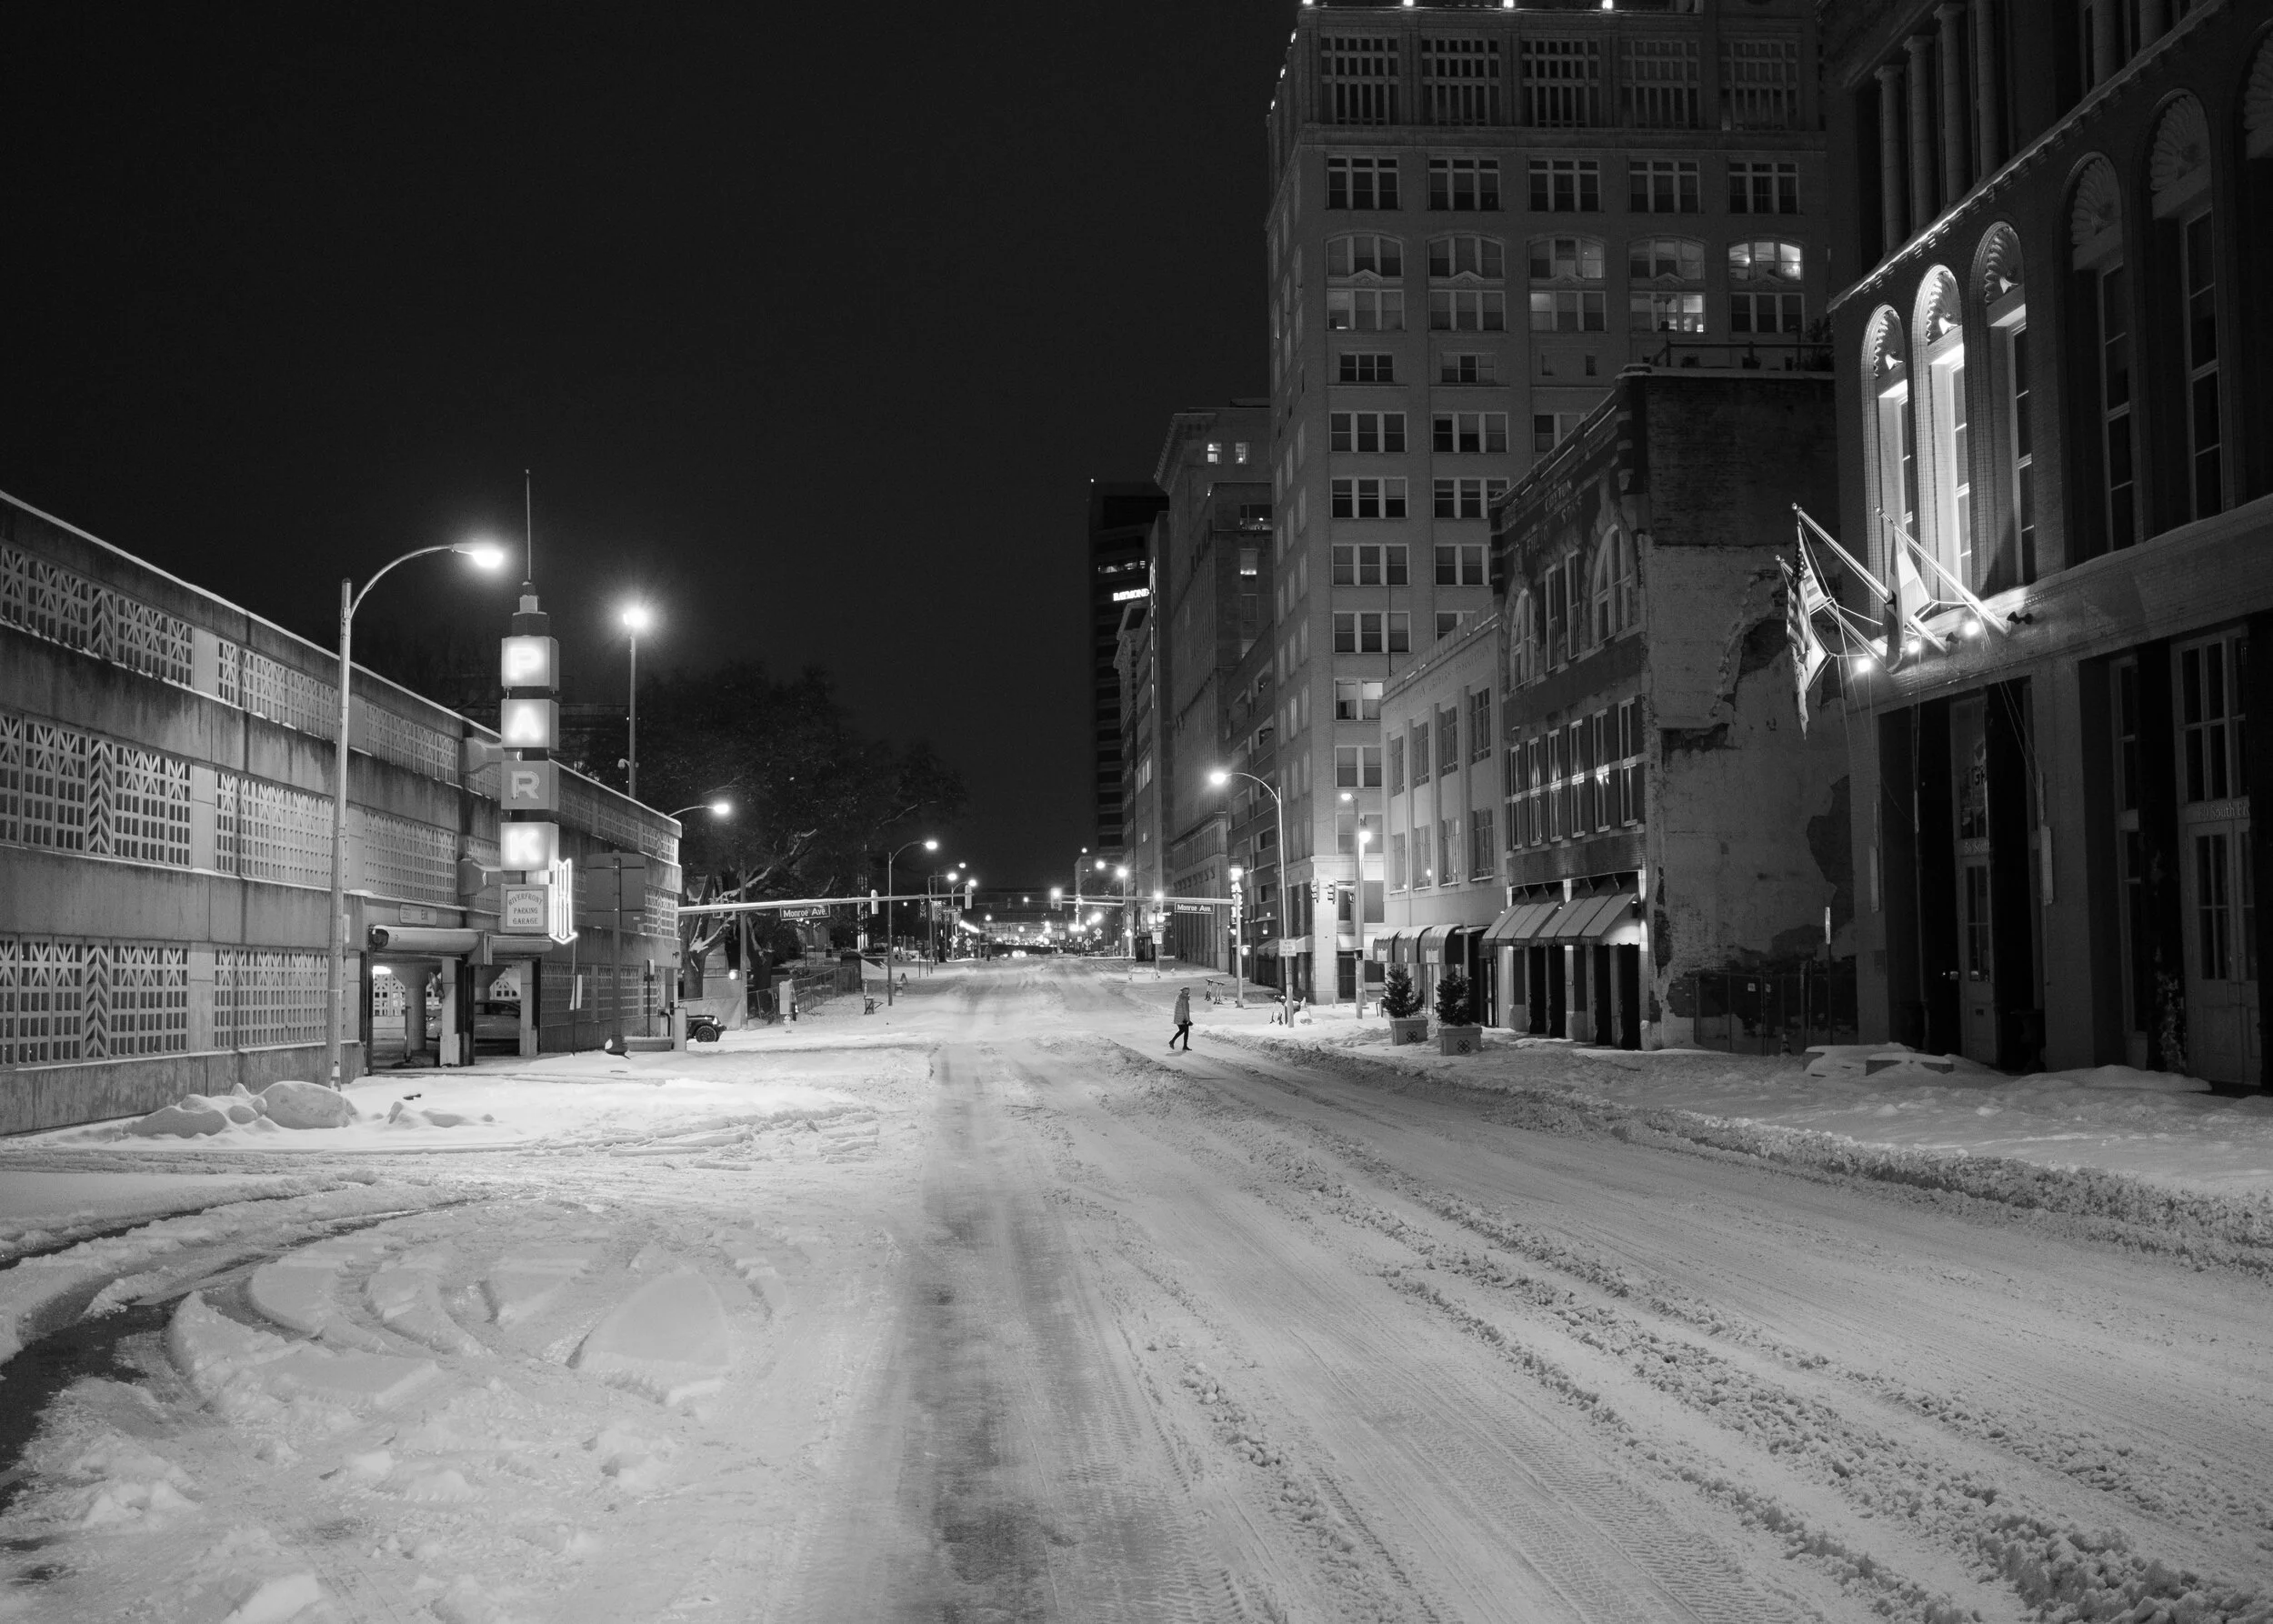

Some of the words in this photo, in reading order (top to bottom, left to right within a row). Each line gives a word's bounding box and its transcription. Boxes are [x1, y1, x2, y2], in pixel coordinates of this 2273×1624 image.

[508, 647, 540, 862] PARK
[507, 892, 544, 907] RIVERFRONT
[513, 907, 538, 915] PARKING
[783, 909, 808, 918] Monroe
[811, 907, 827, 917] Ave.
[1177, 903, 1197, 912] Monroe
